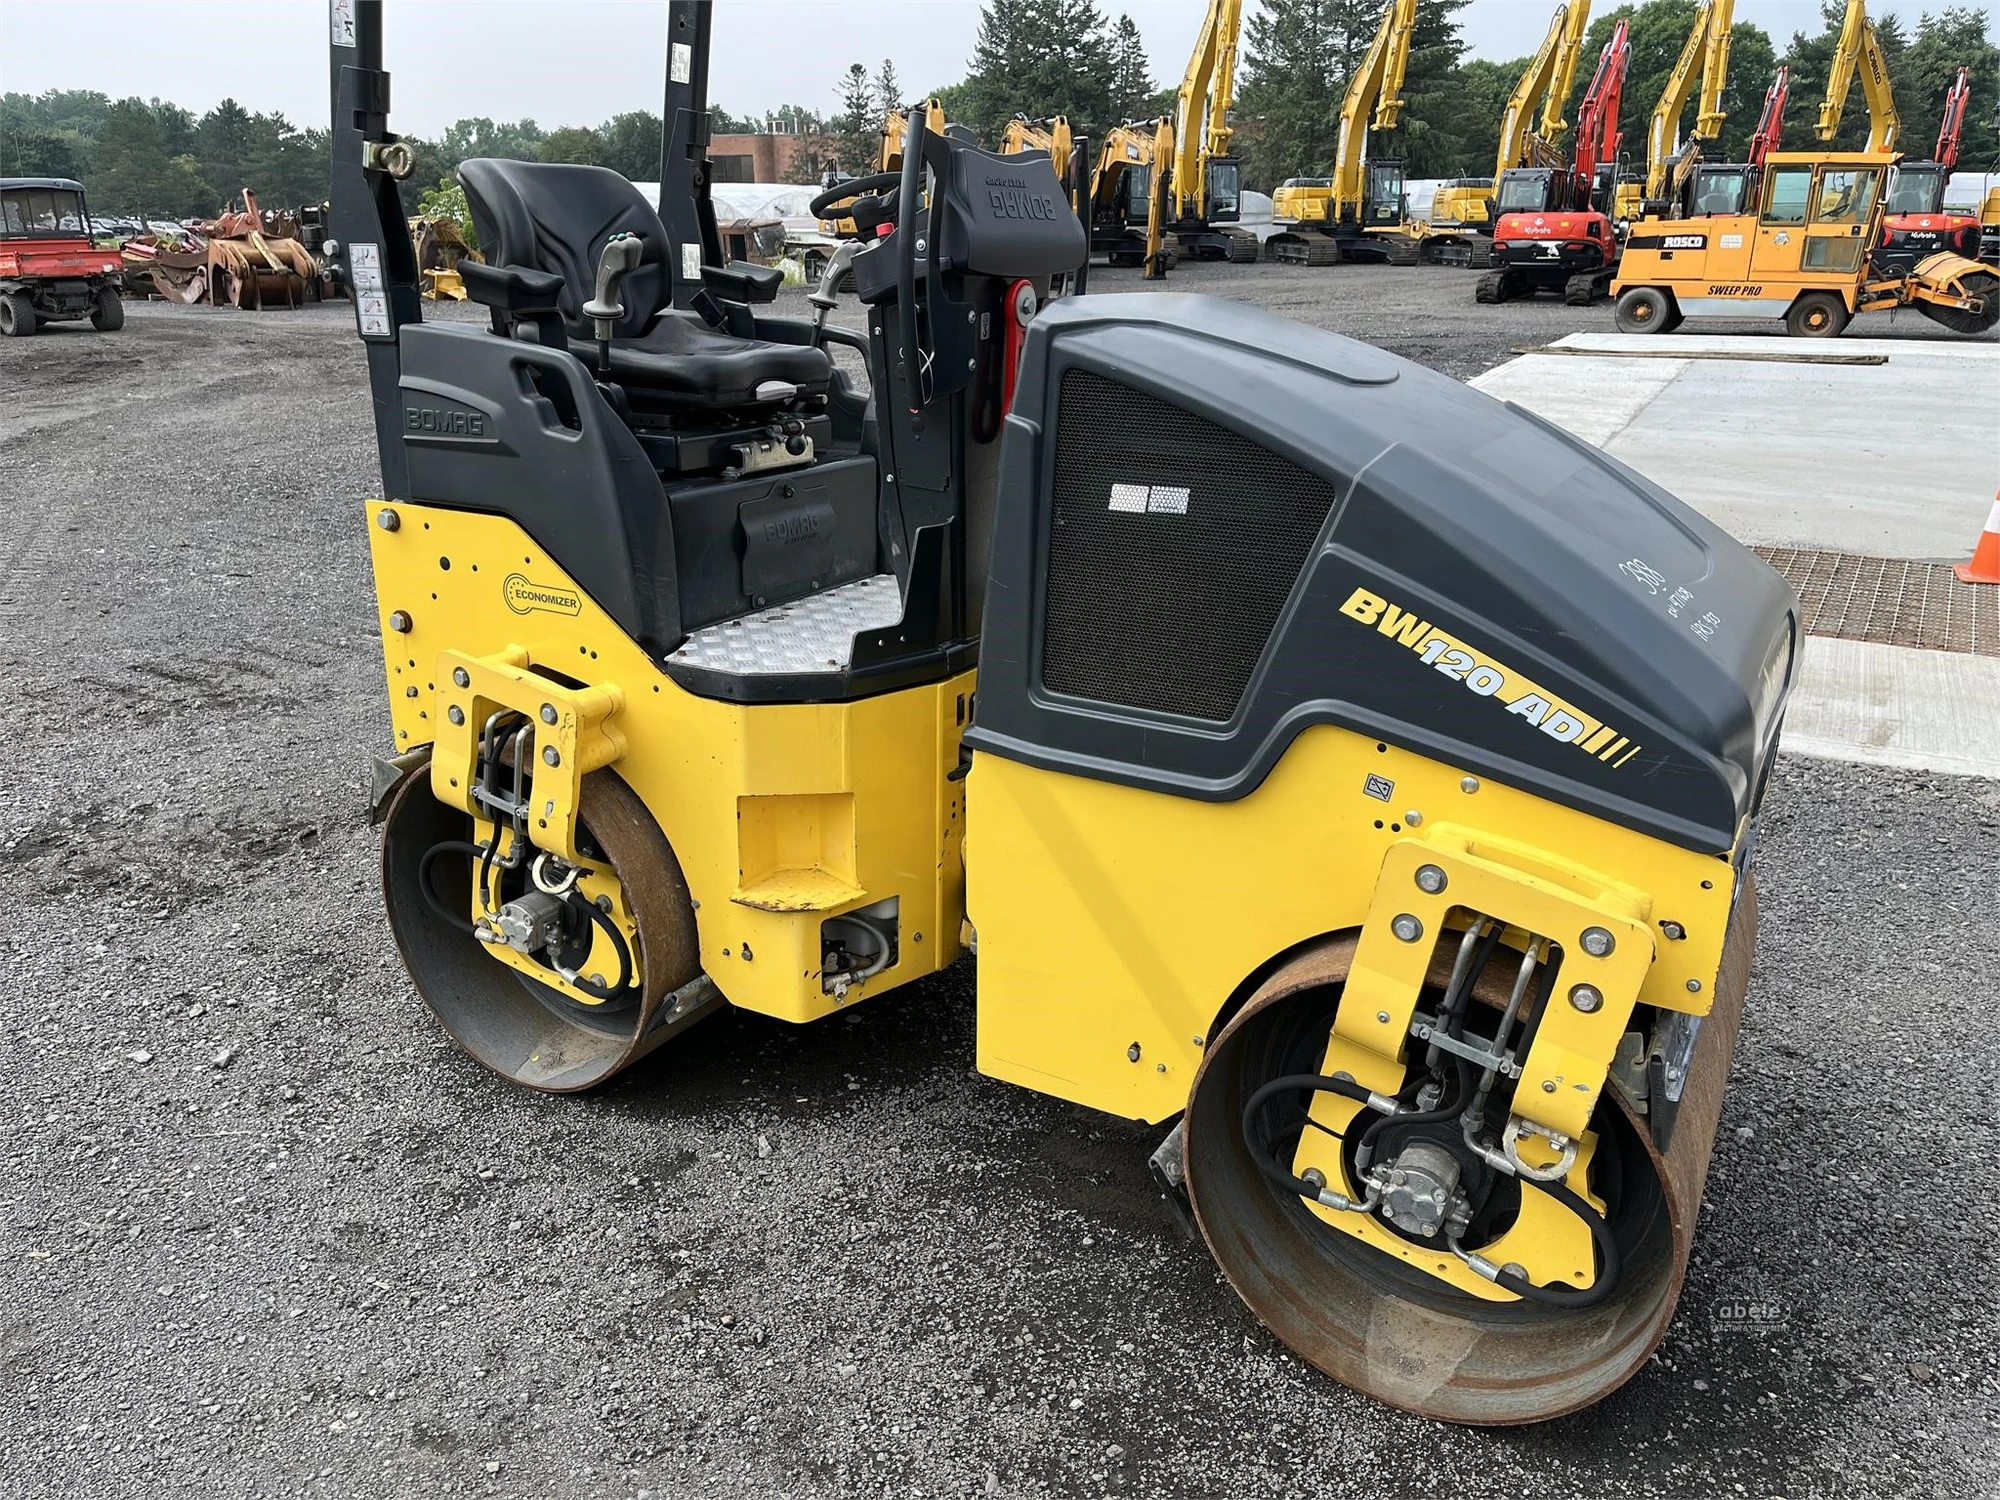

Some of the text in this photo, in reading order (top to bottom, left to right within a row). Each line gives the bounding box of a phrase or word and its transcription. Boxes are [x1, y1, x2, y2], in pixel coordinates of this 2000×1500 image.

[1677, 35, 1699, 82] KOBELCO
[1867, 48, 1882, 86] KOBELCO
[987, 189, 1058, 221] BOMAG
[1523, 226, 1552, 234] Kubota
[1663, 236, 1703, 248] ROSCO
[1910, 231, 1937, 239] Kubota
[1707, 284, 1763, 297] SWEEP PRO
[406, 407, 484, 436] BOMAG
[764, 514, 819, 542] BOMAG
[1618, 558, 1666, 595] 388
[515, 589, 577, 609] ECONOMIZER
[1504, 692, 1586, 744] AD
